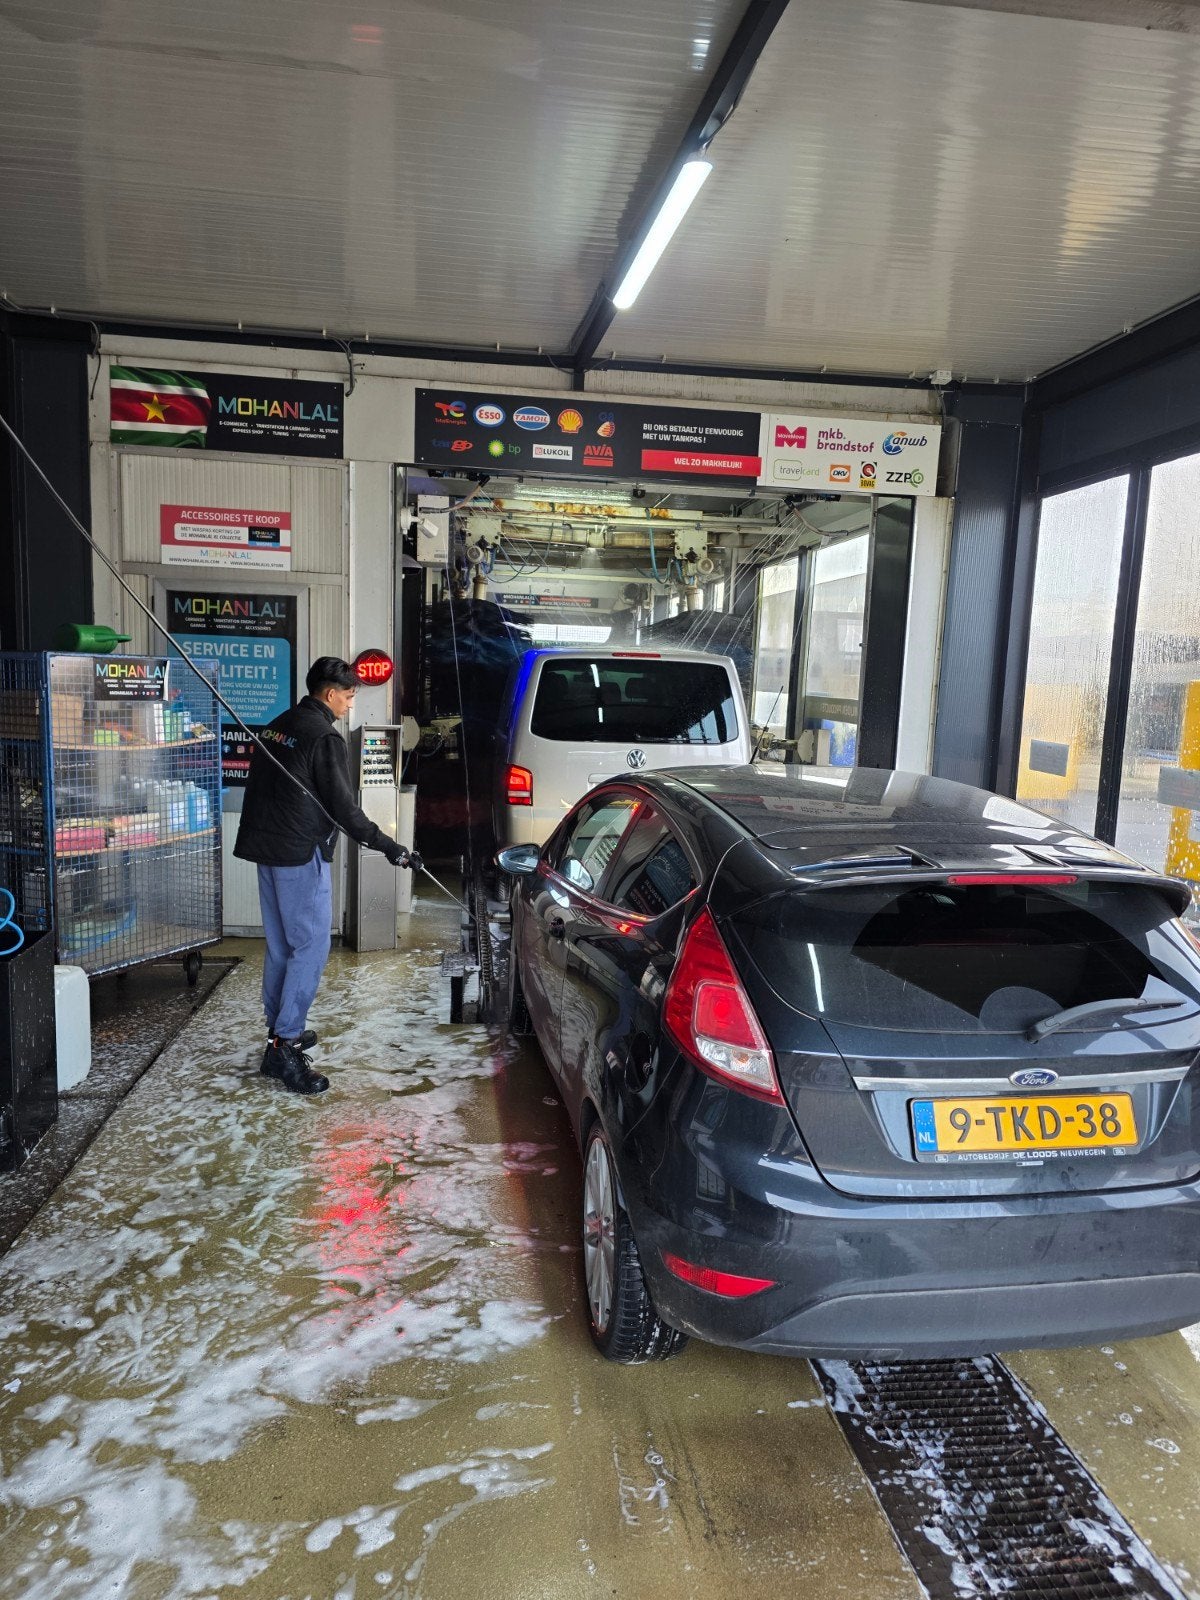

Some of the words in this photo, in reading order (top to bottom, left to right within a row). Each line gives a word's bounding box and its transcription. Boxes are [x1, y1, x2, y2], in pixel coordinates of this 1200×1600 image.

[218, 396, 339, 422] MOHANLAL
[514, 414, 549, 424] TAMOIL
[643, 423, 652, 431] BIJ
[654, 424, 668, 432] ONS
[670, 425, 698, 434] BETAALT
[705, 428, 744, 437] EENVOUDIG
[672, 434, 702, 444] TANKPAS
[892, 436, 928, 446] anwb
[508, 443, 521, 454] bp
[543, 448, 570, 457] LUKOIL
[816, 439, 874, 453] brandstof
[702, 460, 742, 468] MAKKELIJK!
[780, 466, 820, 476] travelcard
[181, 510, 240, 522] ACCESSOIRES
[243, 514, 254, 522] TE
[256, 516, 280, 524] KOOP
[200, 550, 252, 560] MOHANLAL
[174, 597, 286, 618] MOHANLAL
[182, 641, 248, 657] SERVICE
[254, 644, 274, 658] EN
[221, 664, 268, 679] LITEIT
[358, 662, 390, 678] STOP
[1021, 1072, 1049, 1086] Ford
[949, 1102, 1122, 1144] 9-TKD-38
[919, 1132, 934, 1144] NL
[958, 1151, 1010, 1161] AUTOBEDRIJF
[1013, 1151, 1025, 1160] DE
[1026, 1150, 1058, 1158] LOODS
[1060, 1149, 1106, 1158] NIEUWEGEIN
